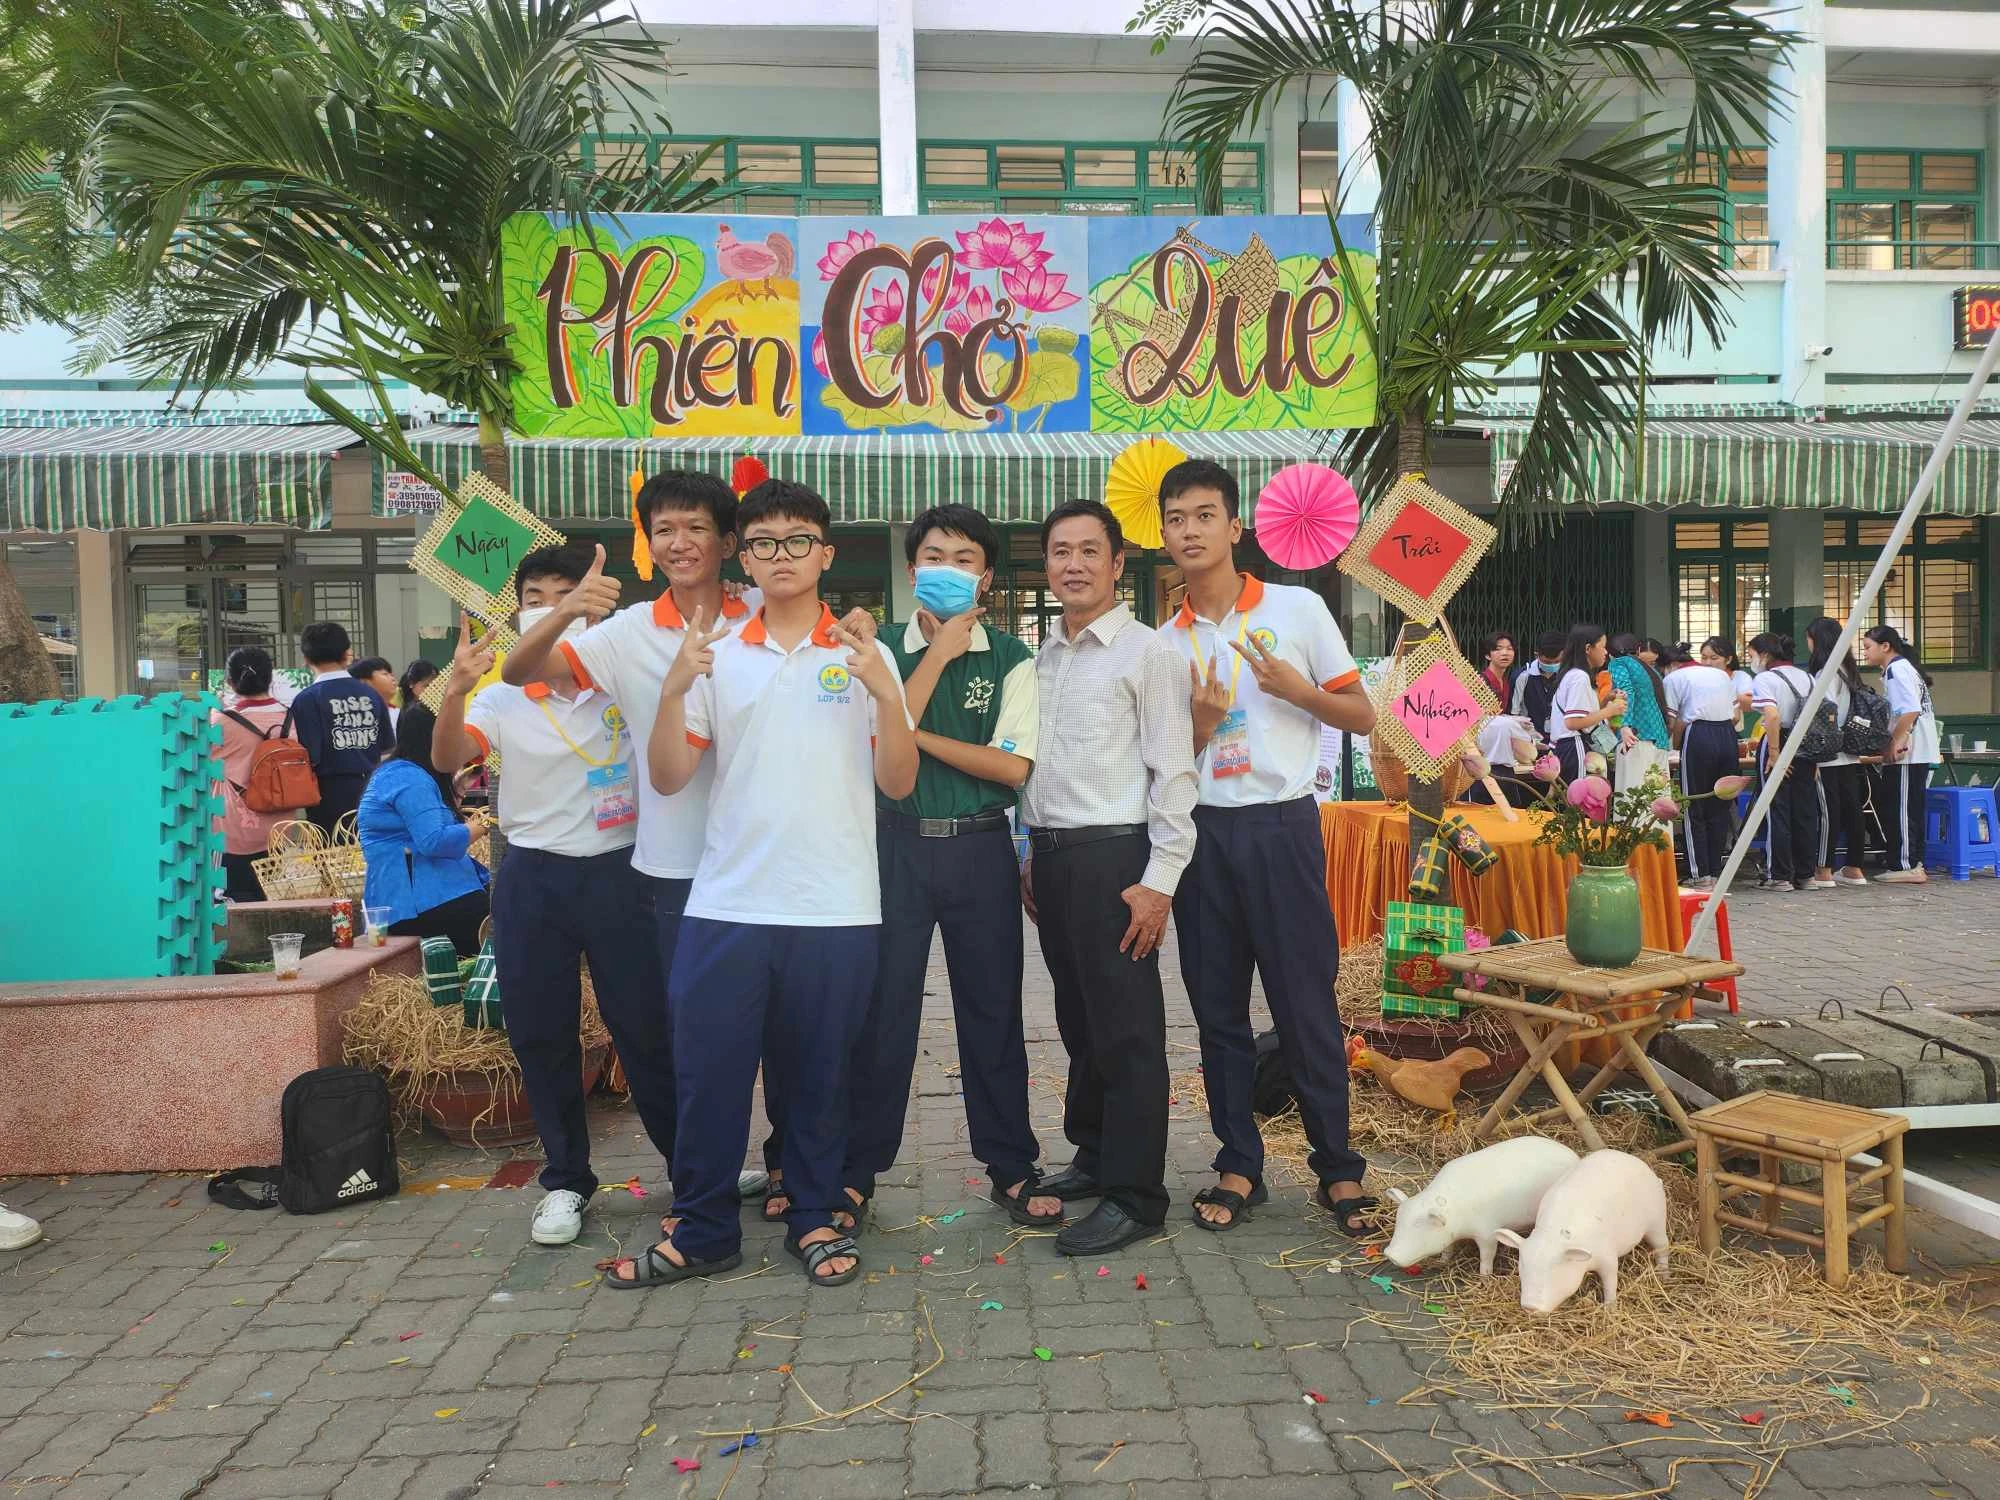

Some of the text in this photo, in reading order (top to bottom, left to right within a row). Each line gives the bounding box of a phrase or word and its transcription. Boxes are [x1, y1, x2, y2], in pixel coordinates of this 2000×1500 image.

[537, 238, 1356, 425] Phiên Chợ Quê
[455, 531, 511, 573] Ngày
[1392, 536, 1442, 559] Trải
[329, 696, 373, 714] RISE
[1403, 689, 1469, 738] Nghiệm
[343, 711, 374, 727] AND
[334, 728, 377, 748] SHINE
[338, 1181, 377, 1198] adidas
